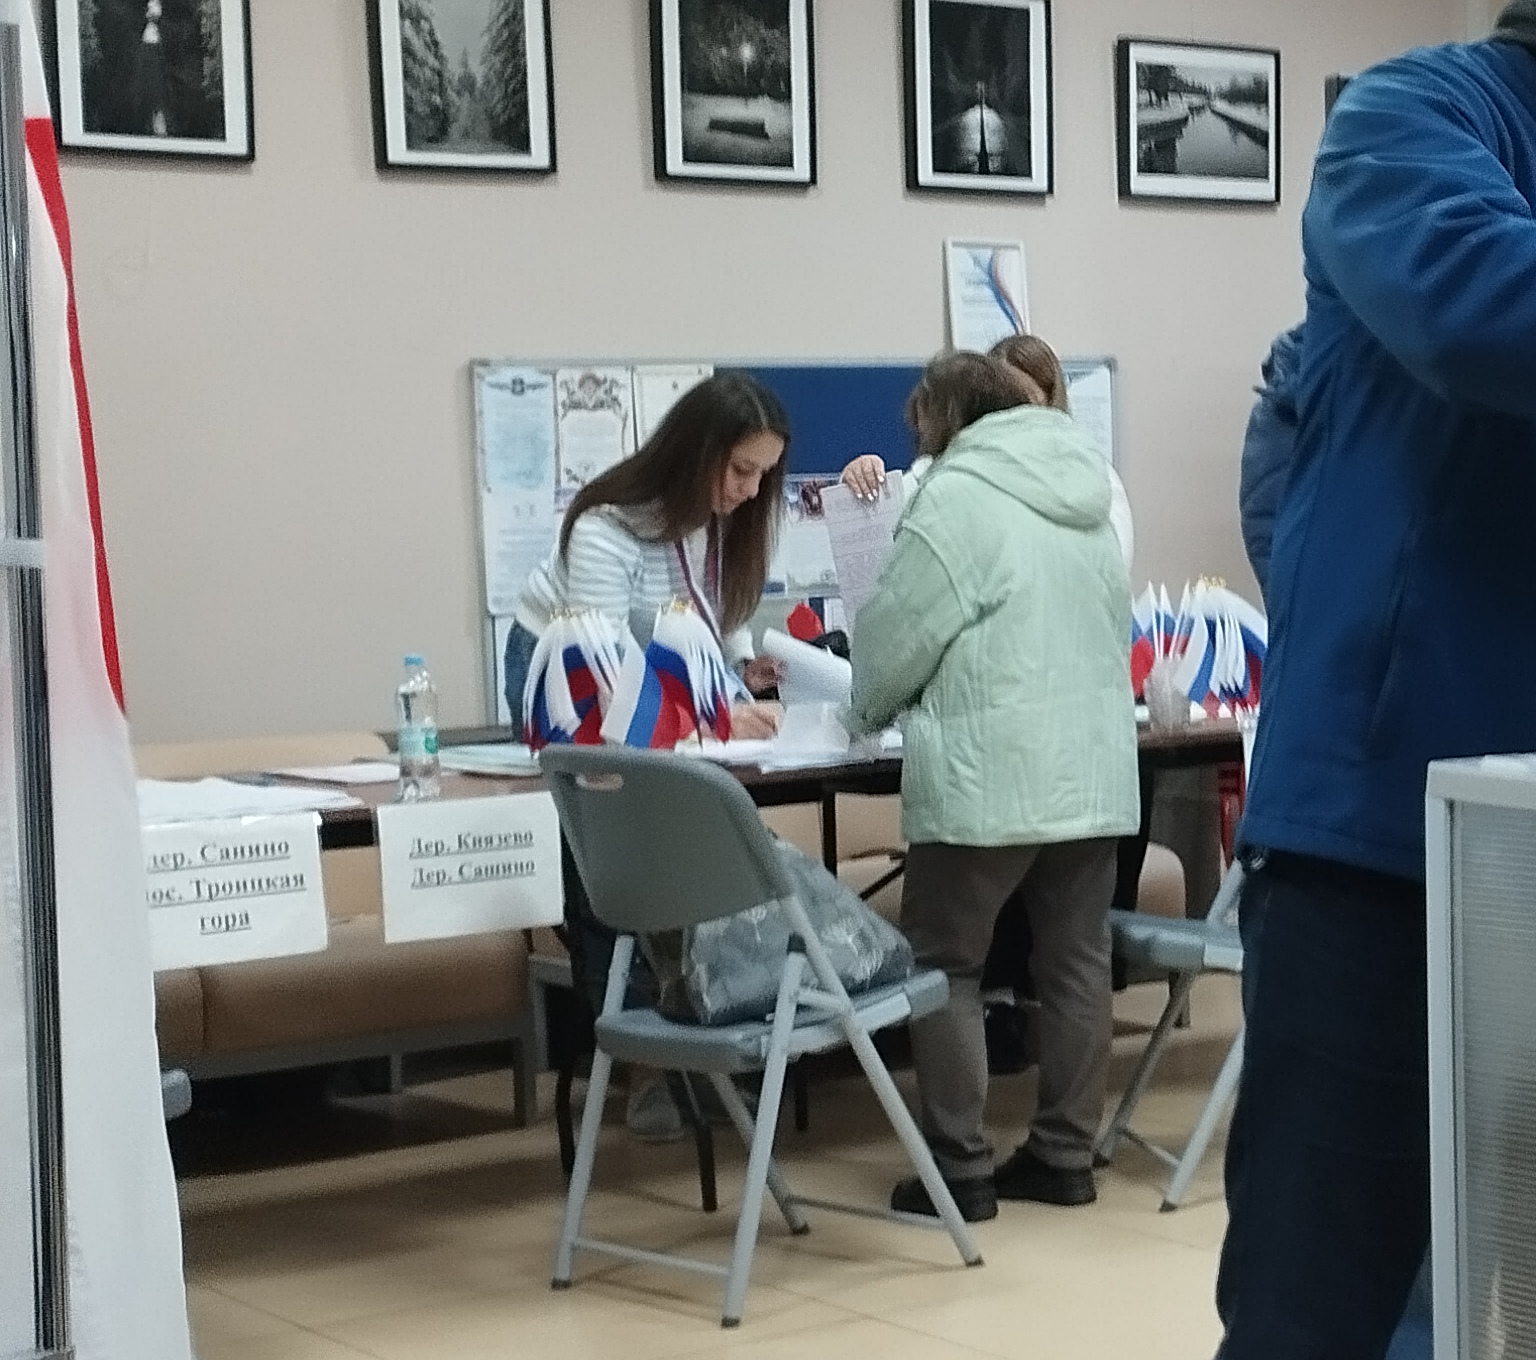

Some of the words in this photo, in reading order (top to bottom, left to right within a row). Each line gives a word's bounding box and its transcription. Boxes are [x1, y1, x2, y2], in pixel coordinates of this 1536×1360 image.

[200, 841, 290, 864] Санино
[409, 837, 452, 860] Дер.
[190, 873, 306, 901] Троицкая
[411, 867, 453, 889] Дер.
[200, 909, 251, 933] гора
